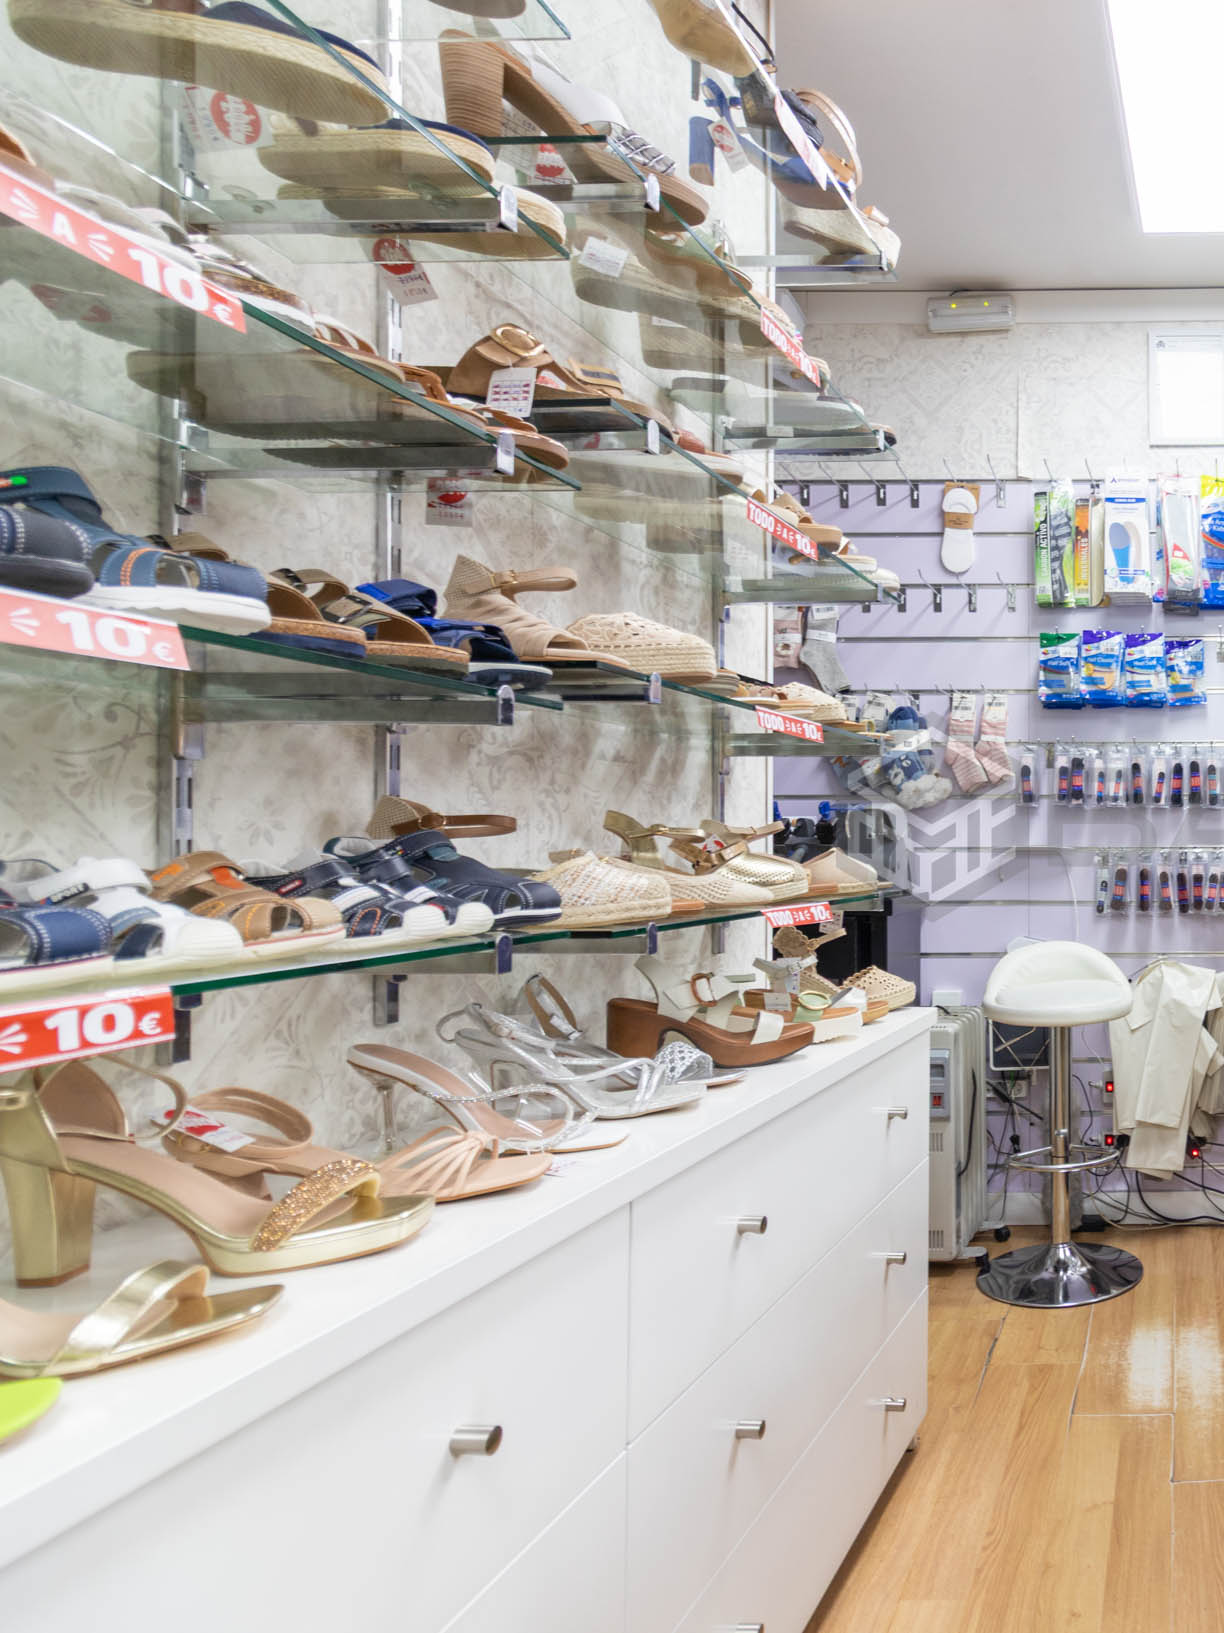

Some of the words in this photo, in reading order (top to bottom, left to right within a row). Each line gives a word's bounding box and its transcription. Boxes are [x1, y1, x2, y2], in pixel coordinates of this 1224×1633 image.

[52, 212, 77, 245] A
[128, 248, 235, 327] 10€
[749, 503, 775, 533] TODO
[782, 527, 788, 539] A
[795, 534, 816, 558] 10€
[56, 610, 176, 662] 10€
[758, 711, 784, 731] TODO
[766, 909, 794, 926] TODO
[44, 1002, 162, 1051] 10€
